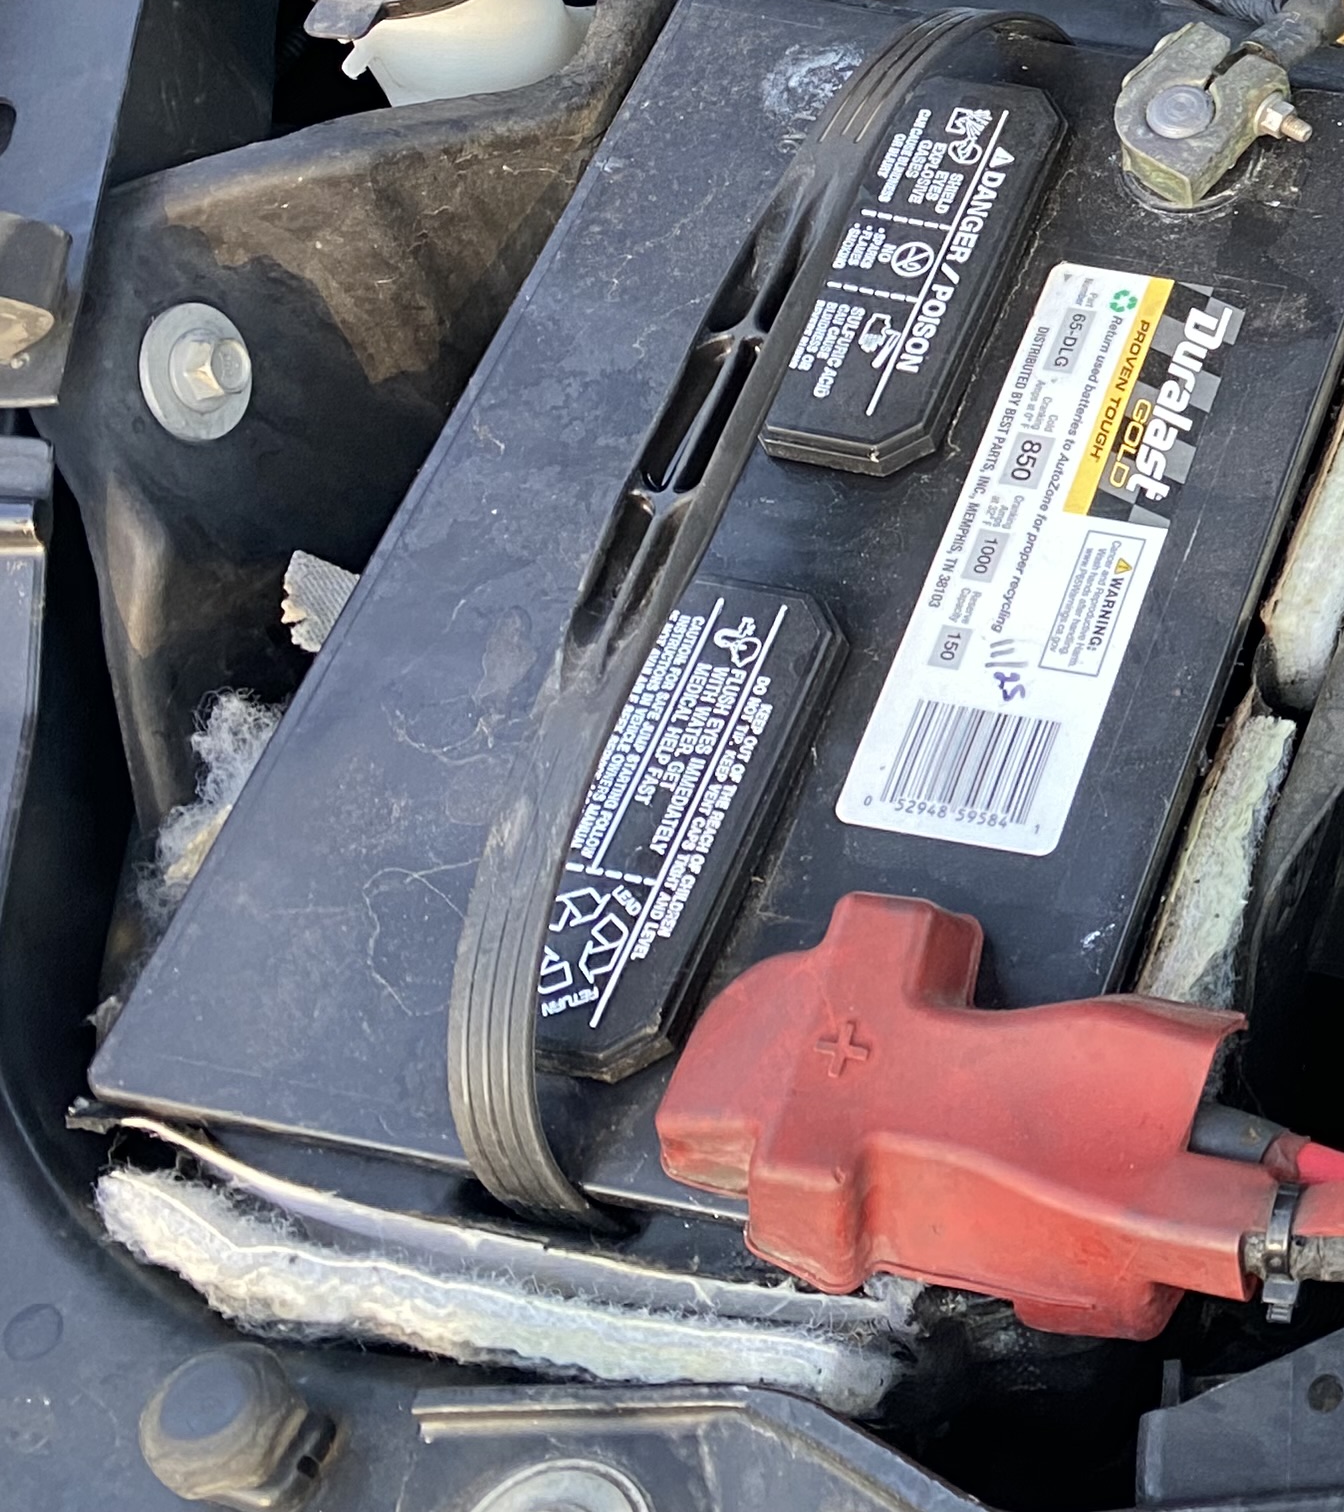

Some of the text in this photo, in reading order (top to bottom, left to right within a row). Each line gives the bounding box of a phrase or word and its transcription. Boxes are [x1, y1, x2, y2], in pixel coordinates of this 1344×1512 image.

[878, 108, 931, 202] CAN CAUSE BLINDNESS
[890, 133, 906, 147] OR
[905, 139, 932, 178] GASES
[908, 142, 947, 204] EXPLOSIVE
[925, 170, 949, 201] EYES
[934, 172, 963, 213] SHIELD
[946, 170, 1005, 262] DANGER
[832, 227, 860, 268] SMOKING
[847, 229, 873, 265] FLAMES
[859, 232, 885, 268] SPARKS
[877, 243, 896, 262] NO
[1084, 292, 1098, 308] Part
[797, 301, 838, 370] BLINDNESS OR
[816, 303, 850, 359] CAN CAUSE
[896, 284, 953, 372] POISON
[1052, 313, 1086, 367] 65-DLG
[813, 306, 865, 397] SULFURIC ACID
[1014, 326, 1050, 389] DISTRIBUTED
[1007, 391, 1023, 406] BY
[1029, 379, 1046, 402] Amps
[1089, 319, 1150, 460] PROVEN TOUGH
[1127, 308, 1231, 499] Duralast
[997, 407, 1016, 435] BEST
[1029, 396, 1052, 430] Cranking
[1043, 414, 1058, 432] Cold
[979, 436, 1006, 472] PARTS,
[1010, 439, 1042, 481] 850
[1109, 398, 1151, 487] GOLD
[990, 314, 1123, 633] Return used batteries to AutoZone for proper recycling
[946, 501, 980, 554] MEMPHIS,
[990, 504, 1008, 527] Amps
[1001, 494, 1025, 529] Cranking
[941, 558, 958, 572] TN
[972, 537, 998, 574] 1000
[1091, 548, 1106, 570] Wash
[1104, 539, 1122, 569] Cancer
[927, 573, 950, 608] 38103
[1080, 571, 1098, 596] hands
[1097, 569, 1109, 586] and
[948, 586, 971, 623] Capacity
[960, 590, 982, 624] Reserve
[1047, 547, 1093, 652] www.P65Warnings.ca.gov
[1072, 586, 1104, 641] Reproductive
[1074, 597, 1086, 617] after
[1086, 577, 1124, 650] WARNING:
[646, 613, 690, 691] INSTRUCTIONS
[939, 632, 961, 661] 150
[660, 666, 682, 690] FOR
[638, 692, 654, 706] IN
[646, 691, 670, 720] SAFE
[616, 707, 648, 752] VEHICLE
[632, 720, 654, 752] JUMP
[634, 662, 712, 805] MEDICAL HELP FAST
[659, 666, 729, 791] WITH WATER. GET
[592, 752, 625, 803] OWNERS
[603, 753, 640, 809] STARTING
[649, 668, 746, 854] FLUSH EYES IMMEDIATELY
[570, 803, 600, 848] MANUAL
[580, 810, 612, 858] FOLLOW
[630, 675, 770, 960] DO NOT TIP. KEEP VENT CAPS TIGHT AND LEVEL
[657, 703, 772, 937] KEEP OUT OF THE REACH OF CHILDREN
[862, 794, 1040, 834] 0 52948 59584 1
[541, 986, 598, 1016] RETURN
